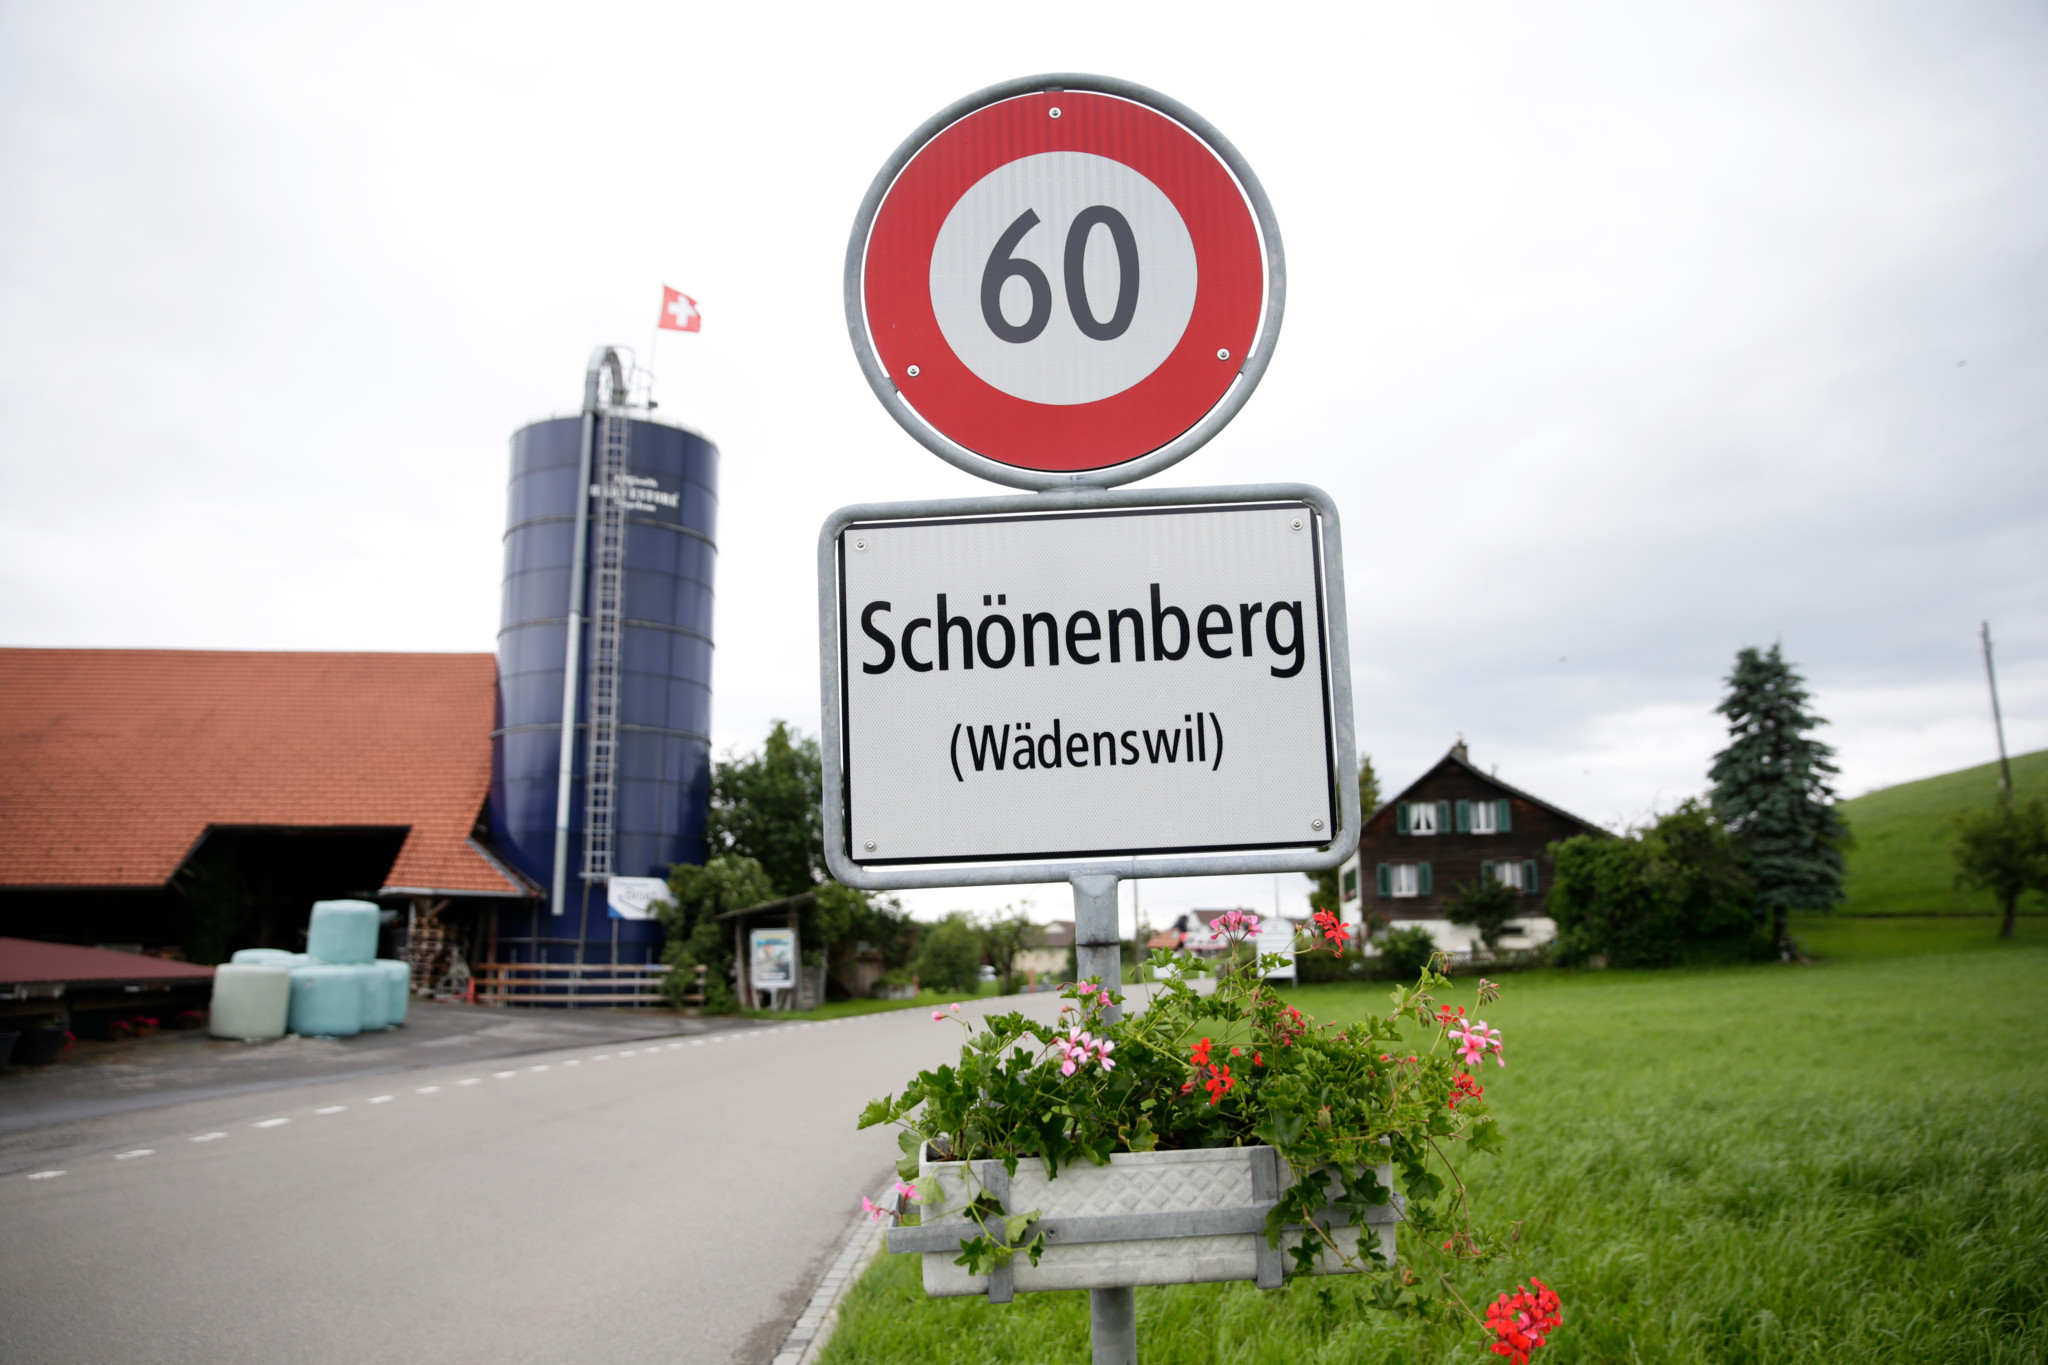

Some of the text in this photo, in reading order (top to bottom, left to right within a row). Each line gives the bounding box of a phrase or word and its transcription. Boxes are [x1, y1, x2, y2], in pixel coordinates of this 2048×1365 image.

[981, 205, 1140, 344] 60
[860, 583, 1306, 679] Schönenberg
[950, 711, 1224, 783] (Wädenswil)
